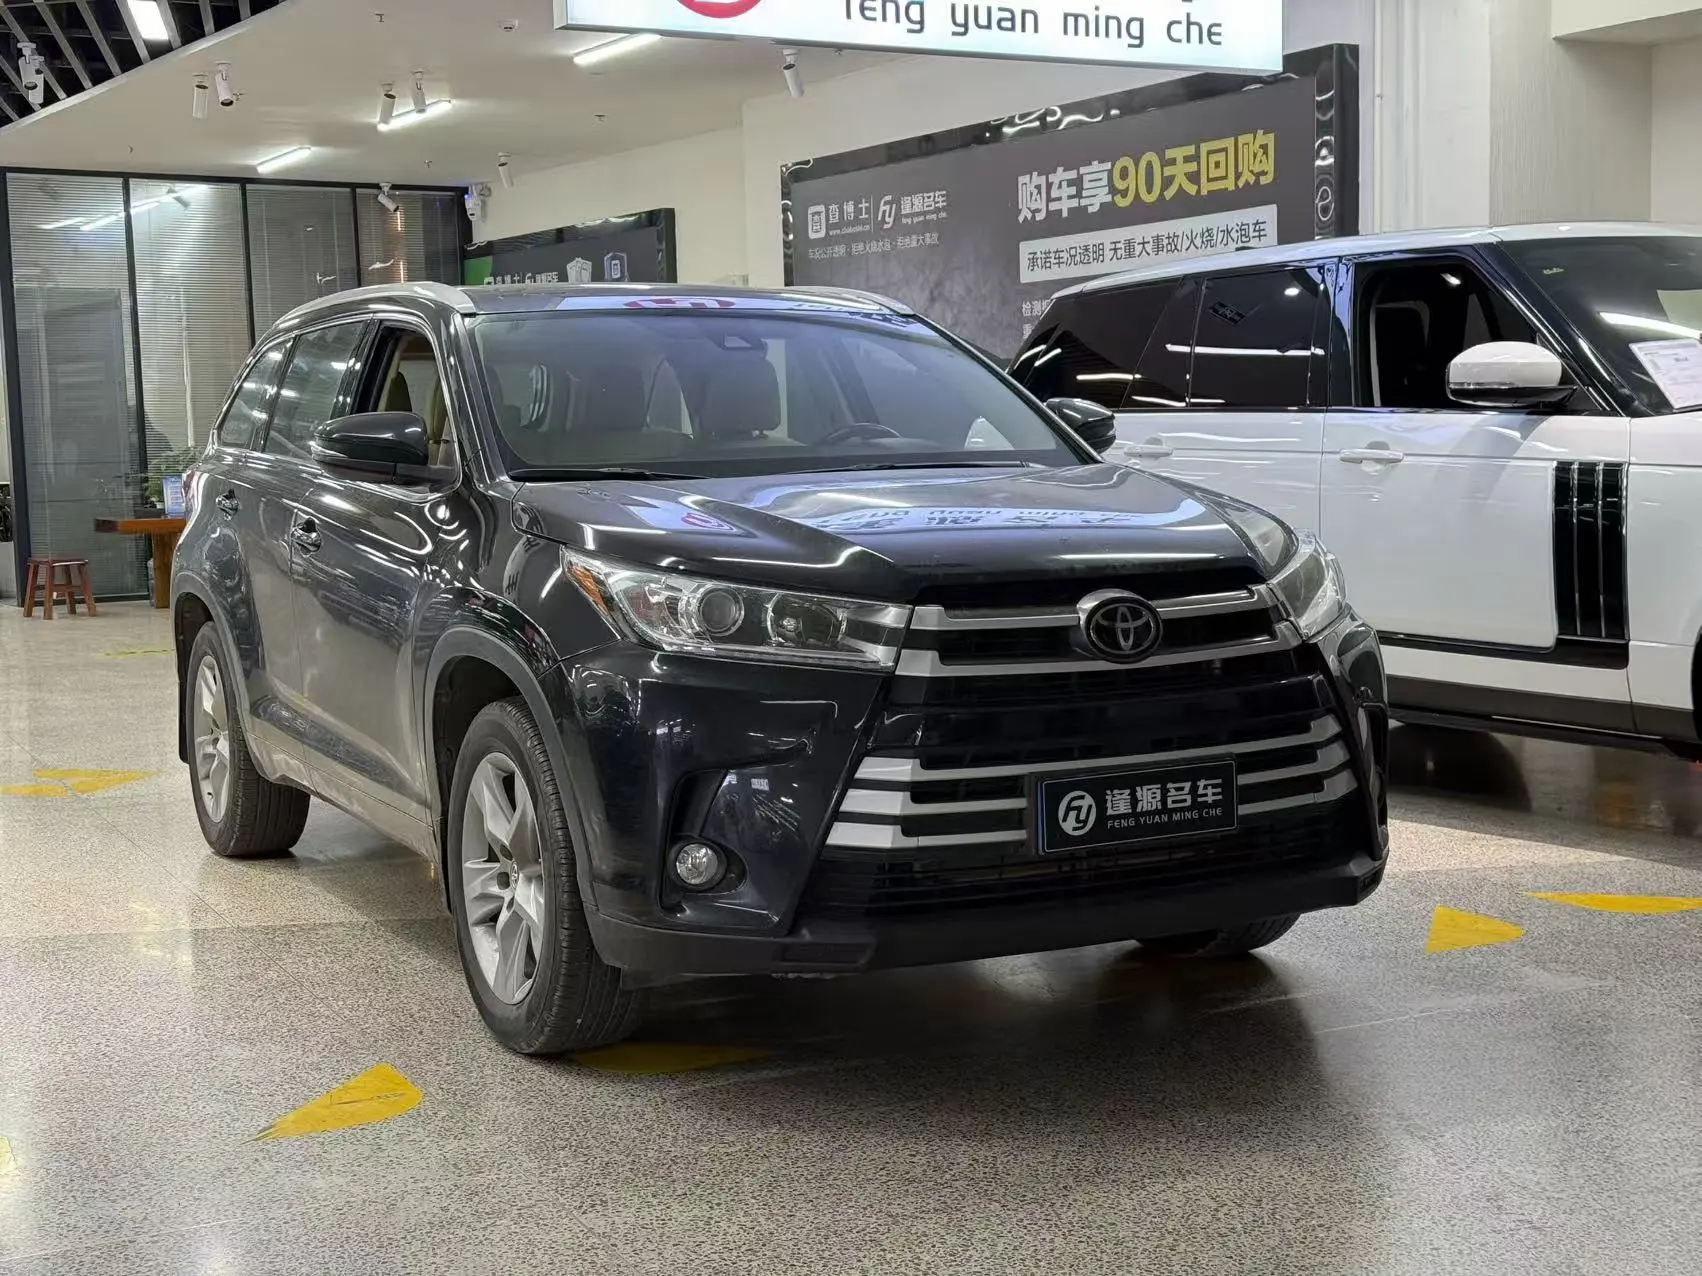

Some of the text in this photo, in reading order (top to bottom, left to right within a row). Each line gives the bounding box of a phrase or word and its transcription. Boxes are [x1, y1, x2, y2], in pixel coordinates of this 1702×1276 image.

[950, 2, 1040, 37] yuan
[1063, 5, 1145, 49] ming
[1166, 12, 1224, 46] che
[1017, 129, 1276, 224] 购车享90天回购
[828, 197, 870, 224] 查博士
[1027, 219, 1268, 273] 承诺车况透明 无重大事故/火烧/水泡车
[1105, 778, 1223, 816] 逢源名车
[1107, 807, 1222, 830] FENG YUAN MING CHE
